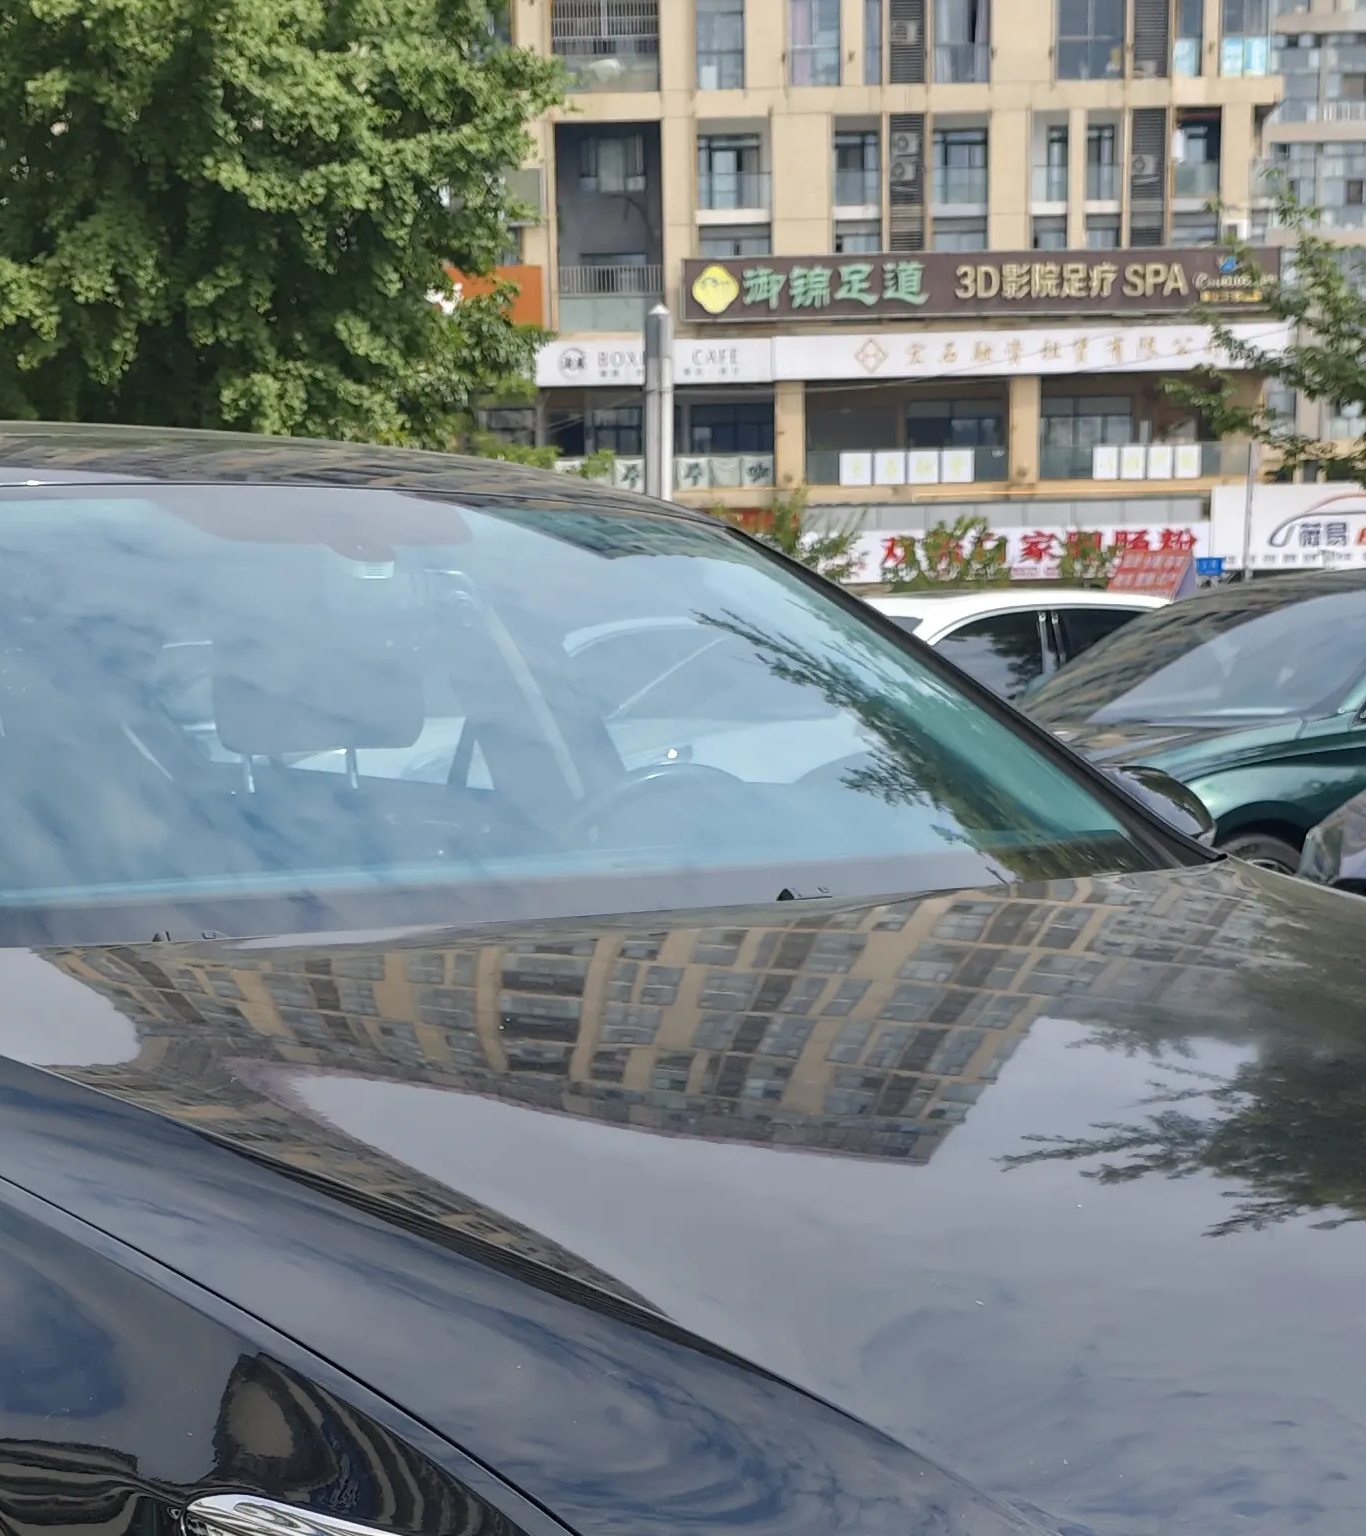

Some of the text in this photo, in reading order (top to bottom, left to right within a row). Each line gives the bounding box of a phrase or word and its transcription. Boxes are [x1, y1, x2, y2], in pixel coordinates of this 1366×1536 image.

[954, 261, 1119, 300] 3D影院足疗
[1122, 262, 1189, 298] SPA
[691, 347, 740, 366] CAFE
